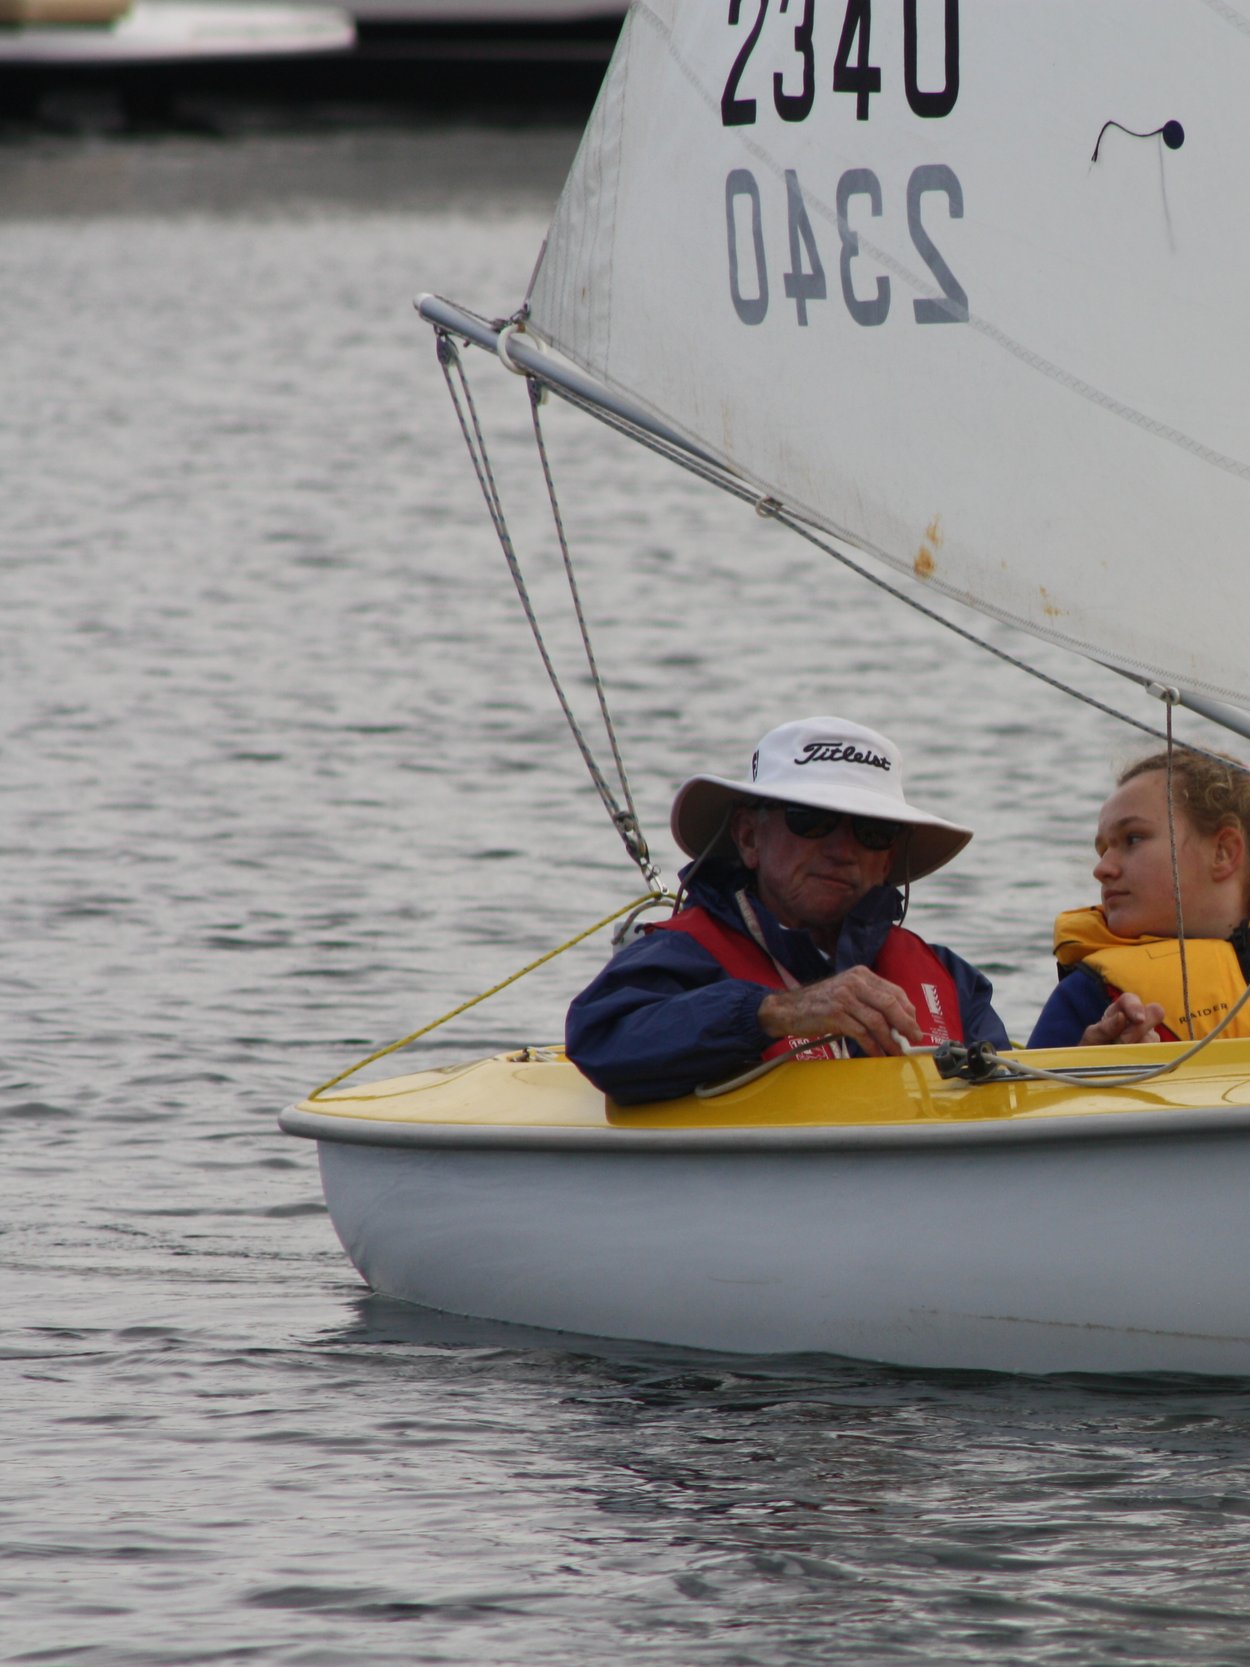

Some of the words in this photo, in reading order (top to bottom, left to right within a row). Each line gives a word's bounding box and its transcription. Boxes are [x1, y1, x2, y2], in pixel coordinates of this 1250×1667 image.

[721, 0, 960, 127] 2340
[794, 742, 892, 772] Titleist
[1178, 1002, 1229, 1025] RAIDER
